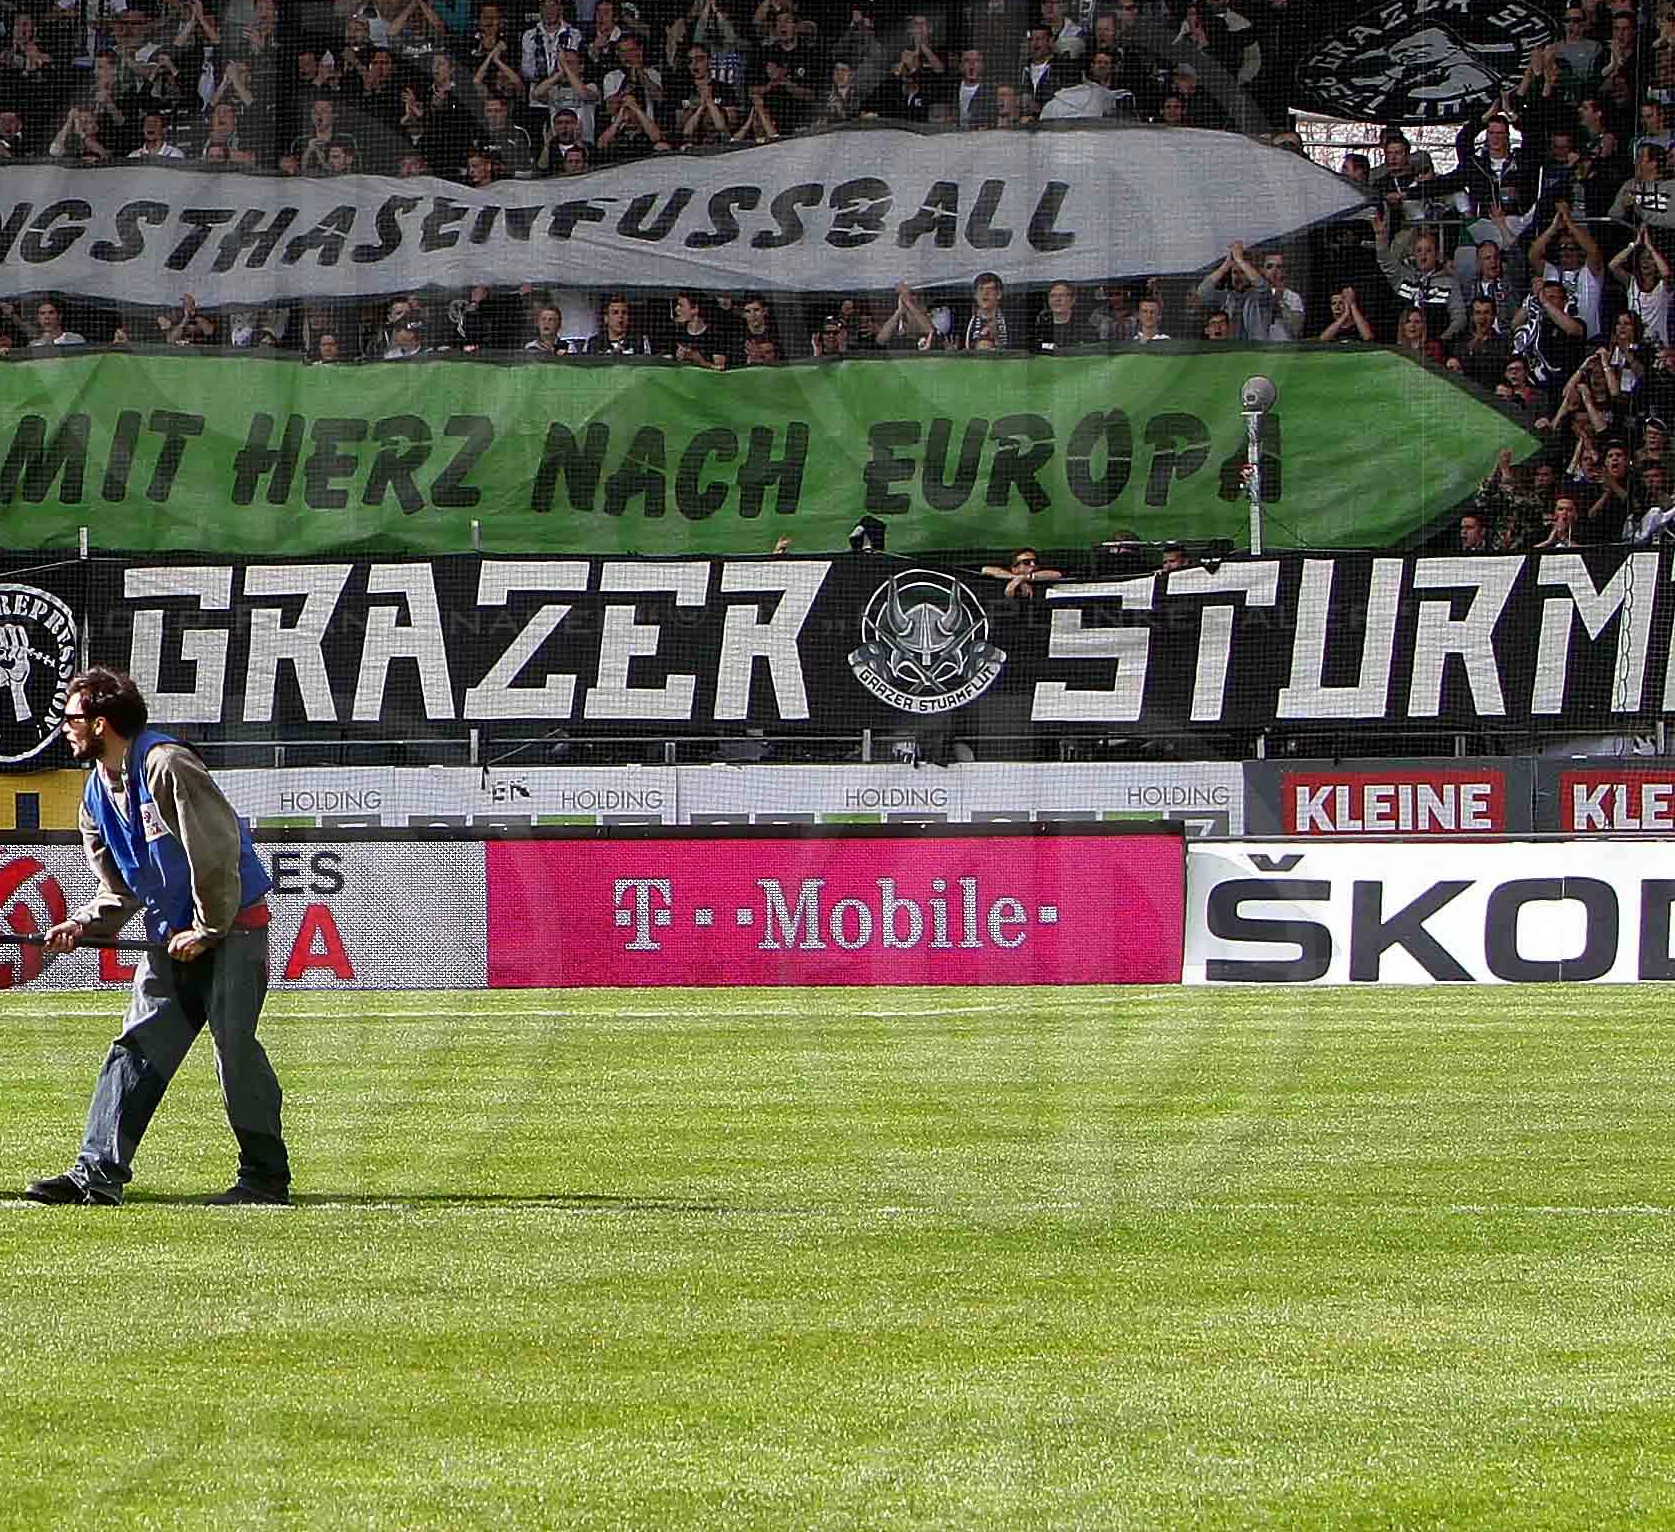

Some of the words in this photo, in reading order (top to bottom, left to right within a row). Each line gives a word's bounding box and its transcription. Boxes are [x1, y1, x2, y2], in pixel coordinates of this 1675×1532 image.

[231, 412, 496, 516] HERZ
[530, 419, 812, 521] NACH
[123, 559, 833, 724] GRAZER
[858, 669, 914, 709] GRAZER
[918, 668, 998, 712] STURMFLUT
[280, 787, 383, 812] HOLDING
[561, 787, 663, 812] HOLDING
[845, 786, 948, 809] HOLDING
[1126, 784, 1230, 807] HOLDING
[1294, 783, 1493, 832] KLEINE
